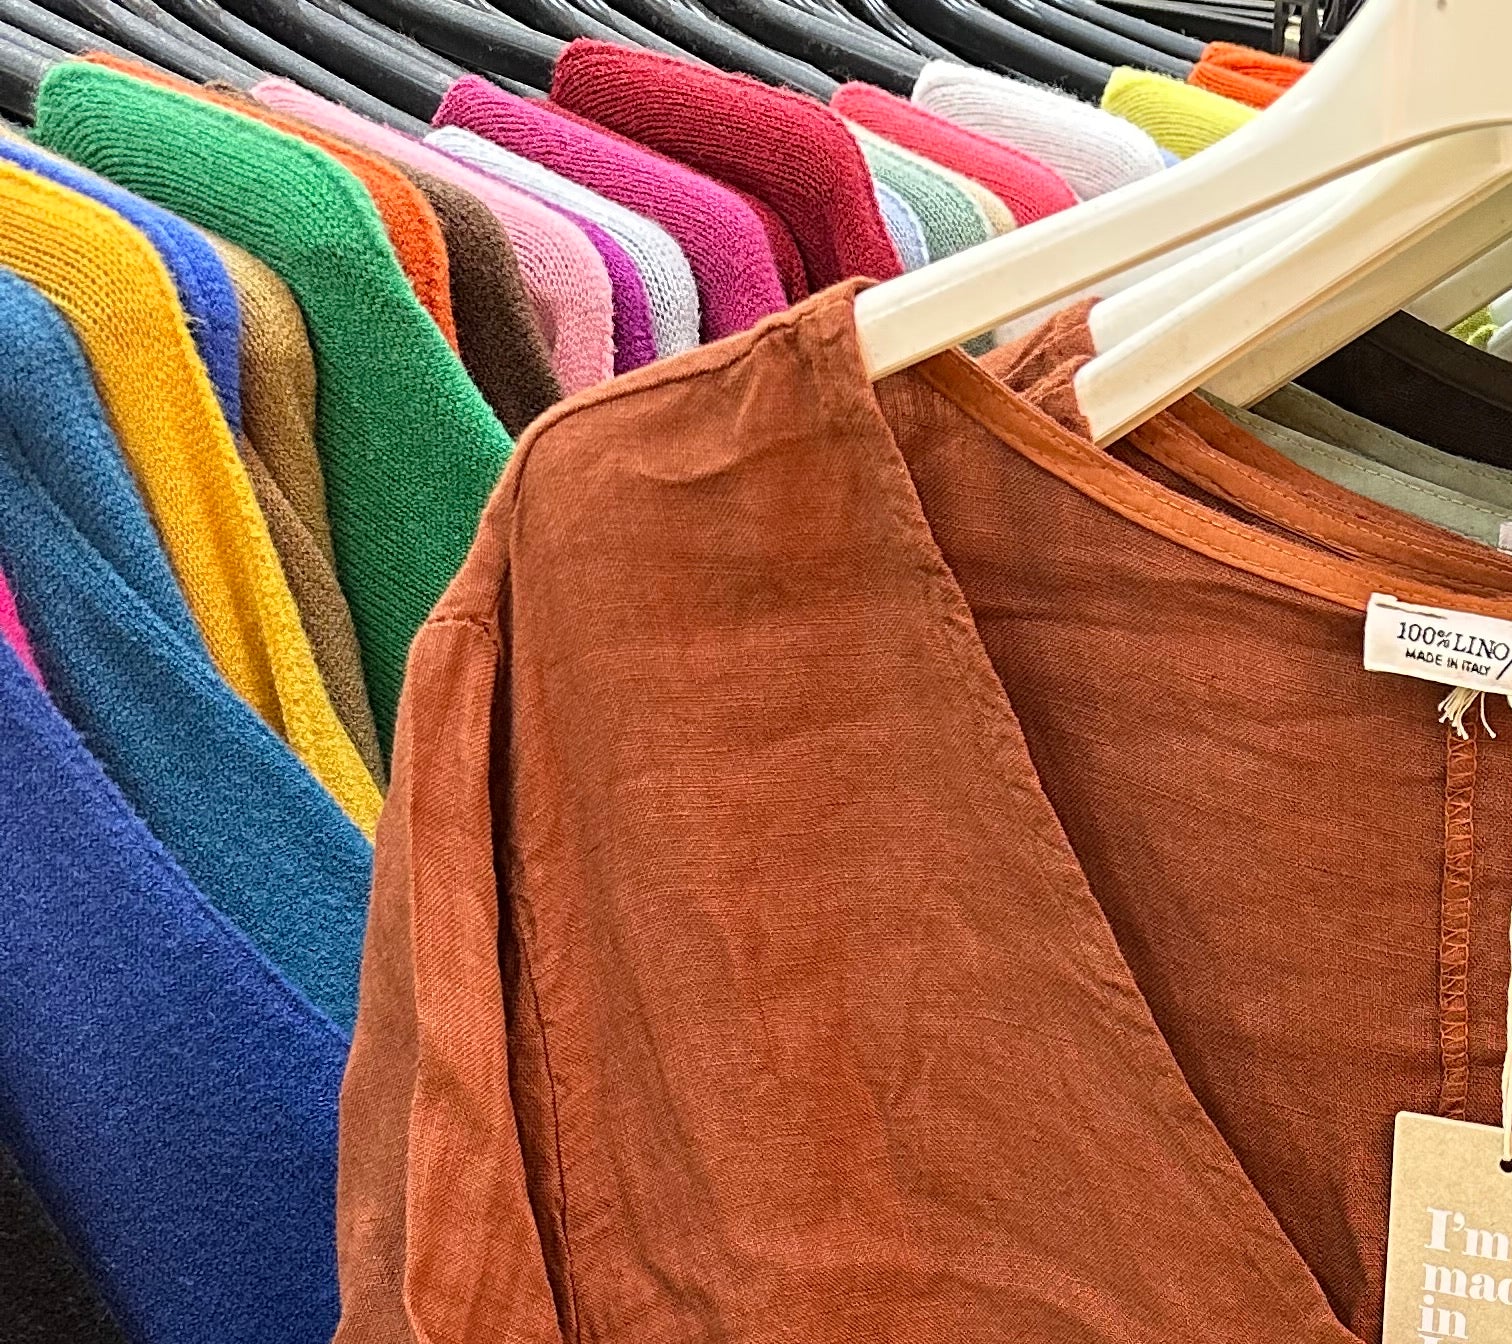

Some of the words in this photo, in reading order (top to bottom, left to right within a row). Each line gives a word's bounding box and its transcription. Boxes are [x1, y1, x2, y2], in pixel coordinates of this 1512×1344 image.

[1405, 647, 1443, 666] MADE
[1446, 656, 1459, 670] IN
[1461, 659, 1491, 677] ITALY
[1423, 1206, 1512, 1262] I'm
[1416, 1294, 1469, 1341] in
